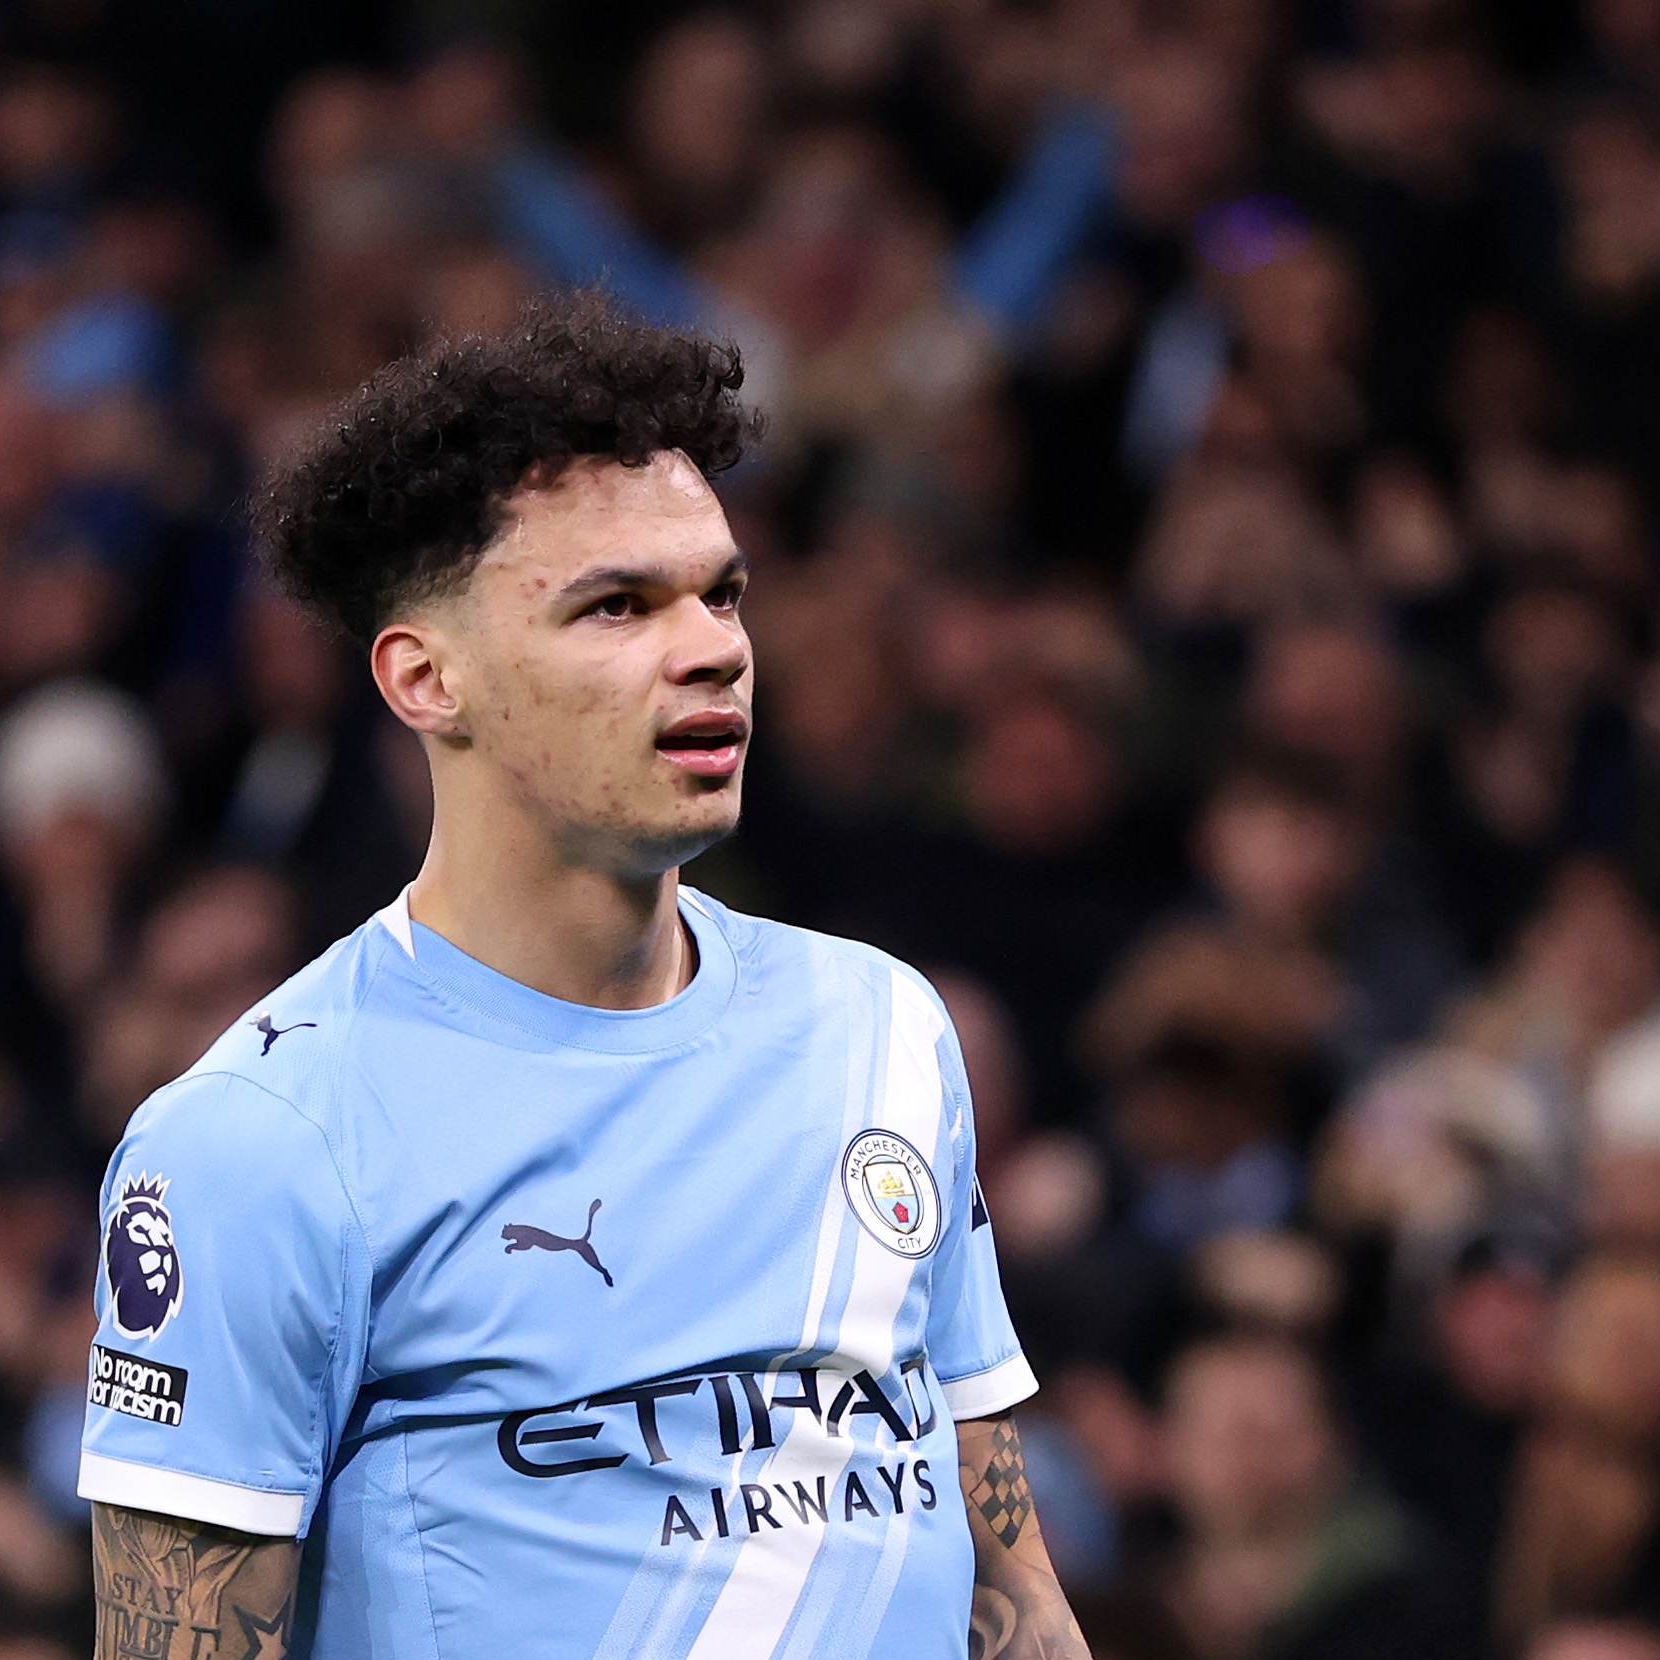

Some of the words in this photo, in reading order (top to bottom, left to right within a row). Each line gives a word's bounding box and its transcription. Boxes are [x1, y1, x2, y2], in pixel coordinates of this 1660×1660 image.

[850, 1139, 922, 1181] MANCHESTER
[897, 1237, 922, 1250] CITY
[93, 1346, 113, 1378] No
[114, 1358, 172, 1396] room
[497, 1359, 938, 1479] ETIHAD
[660, 1458, 937, 1547] AIRWAYS
[112, 1573, 184, 1616] STAY
